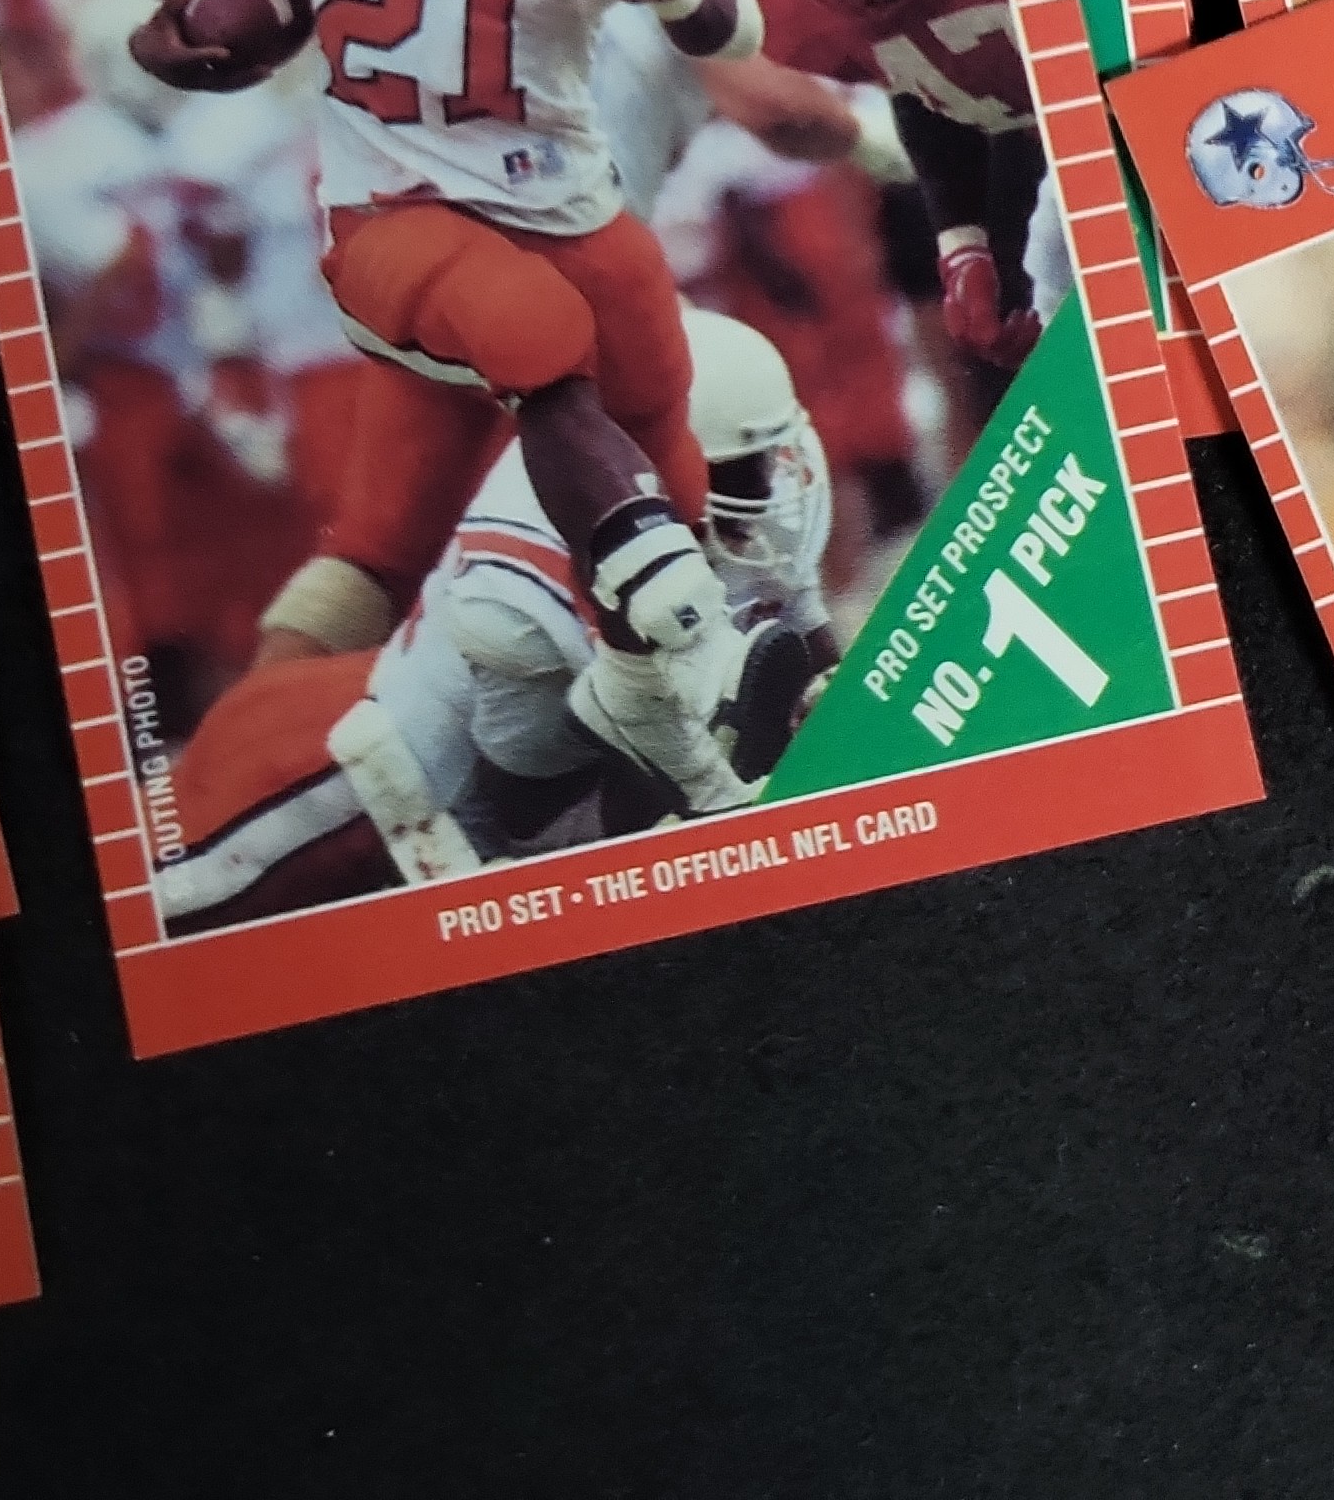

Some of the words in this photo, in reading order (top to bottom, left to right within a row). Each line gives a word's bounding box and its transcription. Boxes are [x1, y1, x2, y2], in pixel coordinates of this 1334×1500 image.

[862, 627, 920, 703] PRO
[904, 563, 956, 633] SET
[940, 405, 1052, 574] PROSPECT
[1009, 452, 1108, 587] PICK
[120, 655, 165, 749] PHOTO
[911, 661, 993, 747] NO.
[982, 568, 1110, 708] 1
[437, 900, 503, 941] PRO
[507, 885, 564, 925] SET
[585, 866, 649, 907] THE
[651, 836, 790, 893] OFFICIAL
[791, 821, 852, 860] NFL
[855, 801, 938, 846] CARD
